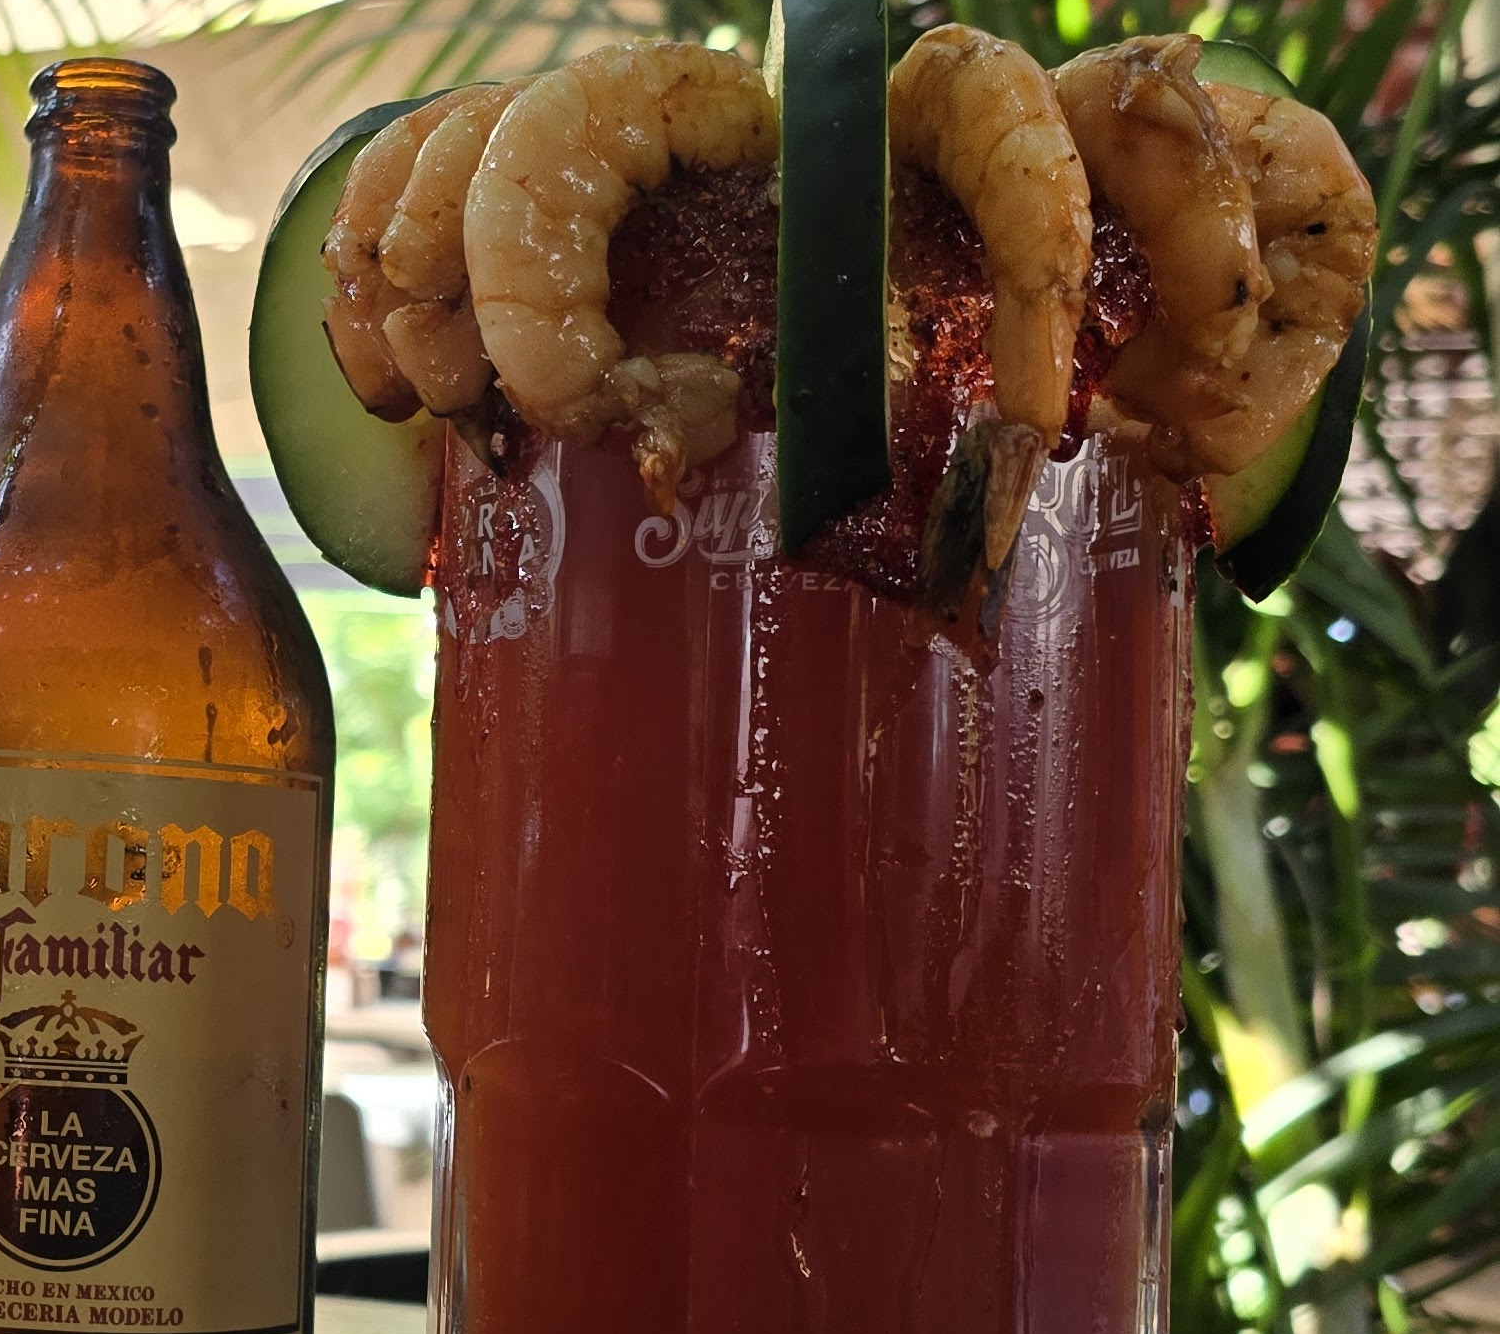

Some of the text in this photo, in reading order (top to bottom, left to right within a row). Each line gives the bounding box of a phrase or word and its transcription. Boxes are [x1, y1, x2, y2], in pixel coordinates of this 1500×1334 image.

[40, 1110, 84, 1138] LA
[22, 1175, 96, 1204] MAS
[19, 1207, 96, 1237] FINA
[42, 1282, 71, 1299] EN
[76, 1283, 156, 1302] MEXICO
[89, 1306, 184, 1327] MODELO
